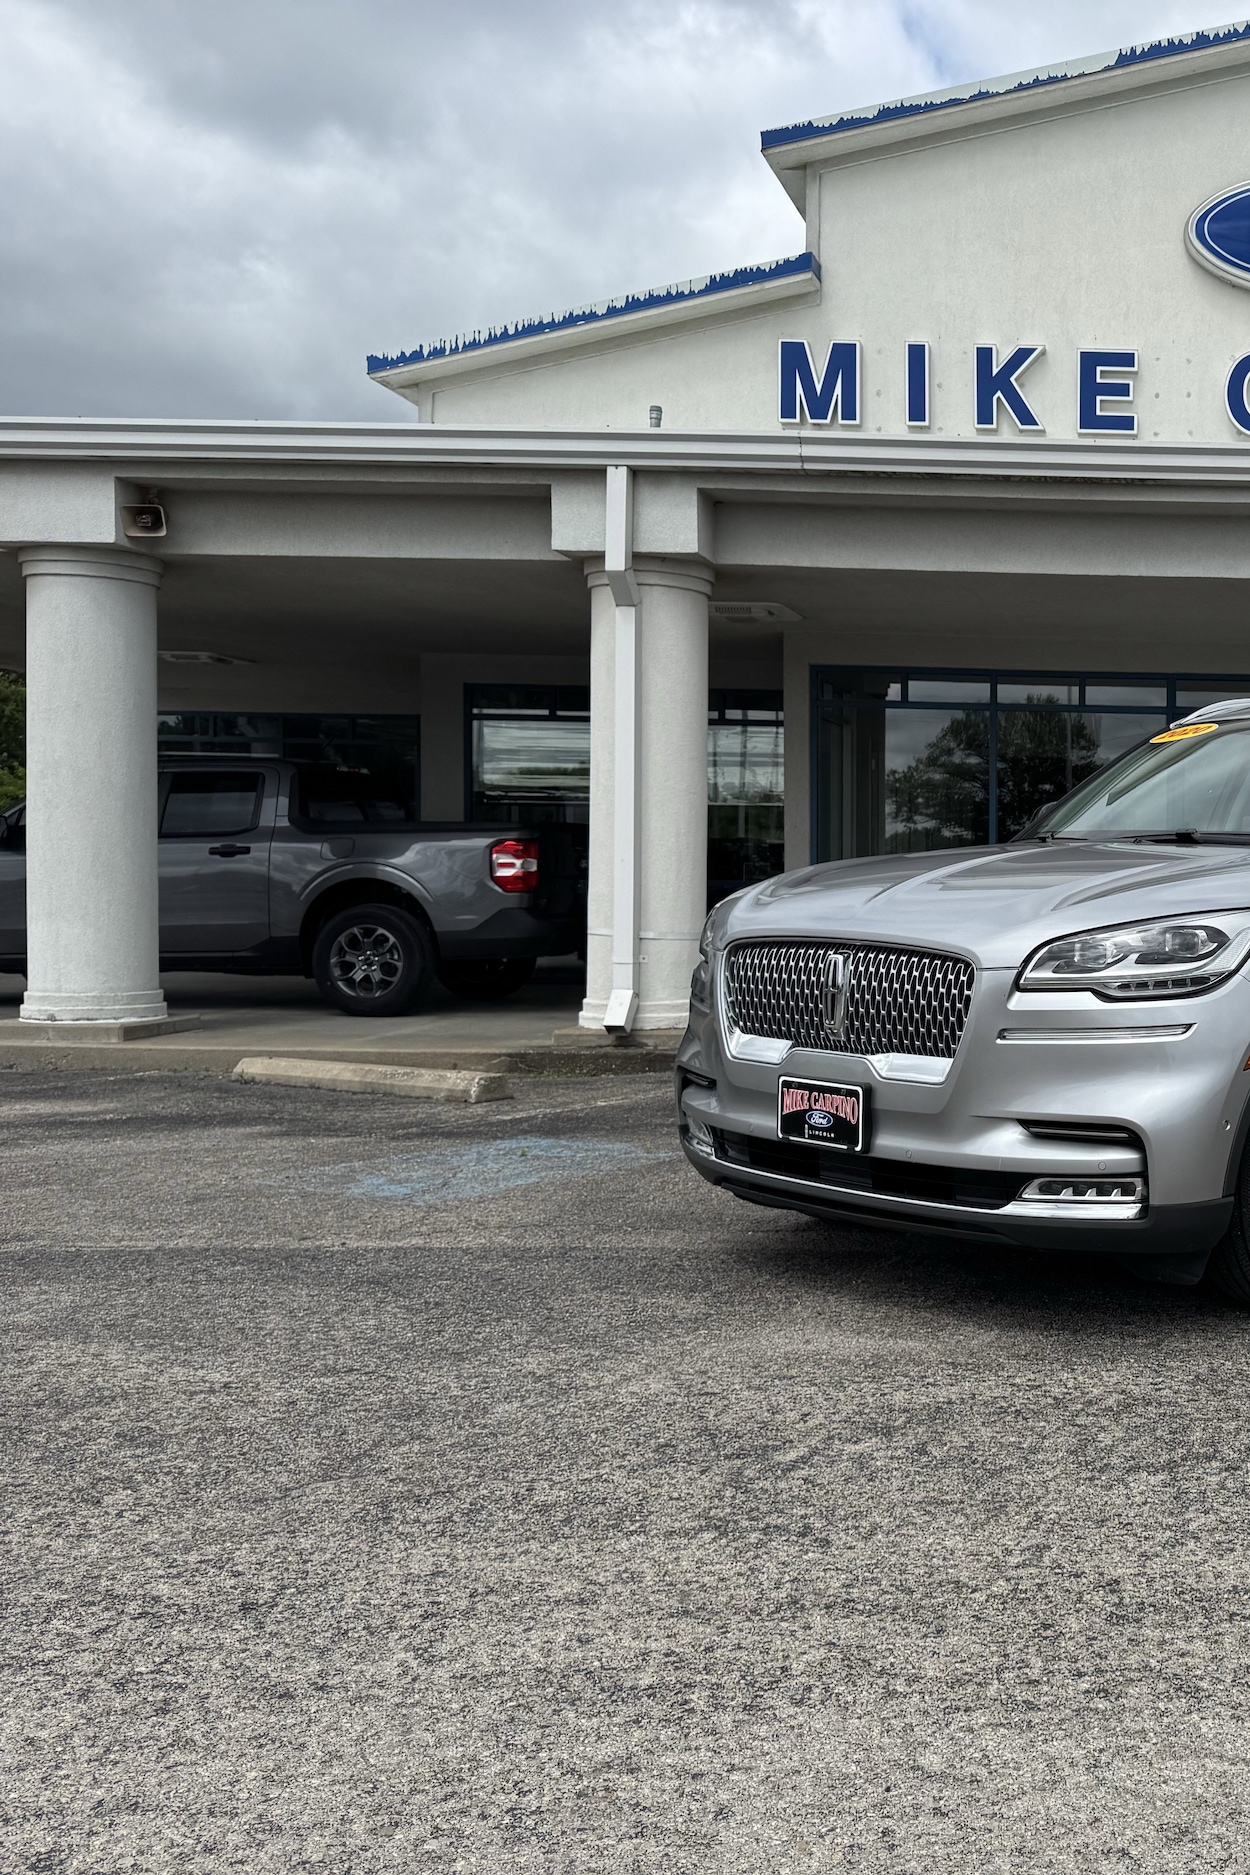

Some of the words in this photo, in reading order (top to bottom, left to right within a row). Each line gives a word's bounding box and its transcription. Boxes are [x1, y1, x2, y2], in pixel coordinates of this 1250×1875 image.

[778, 339, 1139, 435] MIKE
[783, 1088, 809, 1115] MIKE
[810, 1092, 858, 1124] CARPINO
[810, 1112, 828, 1125] Ford
[809, 1130, 835, 1138] LINCOLN
